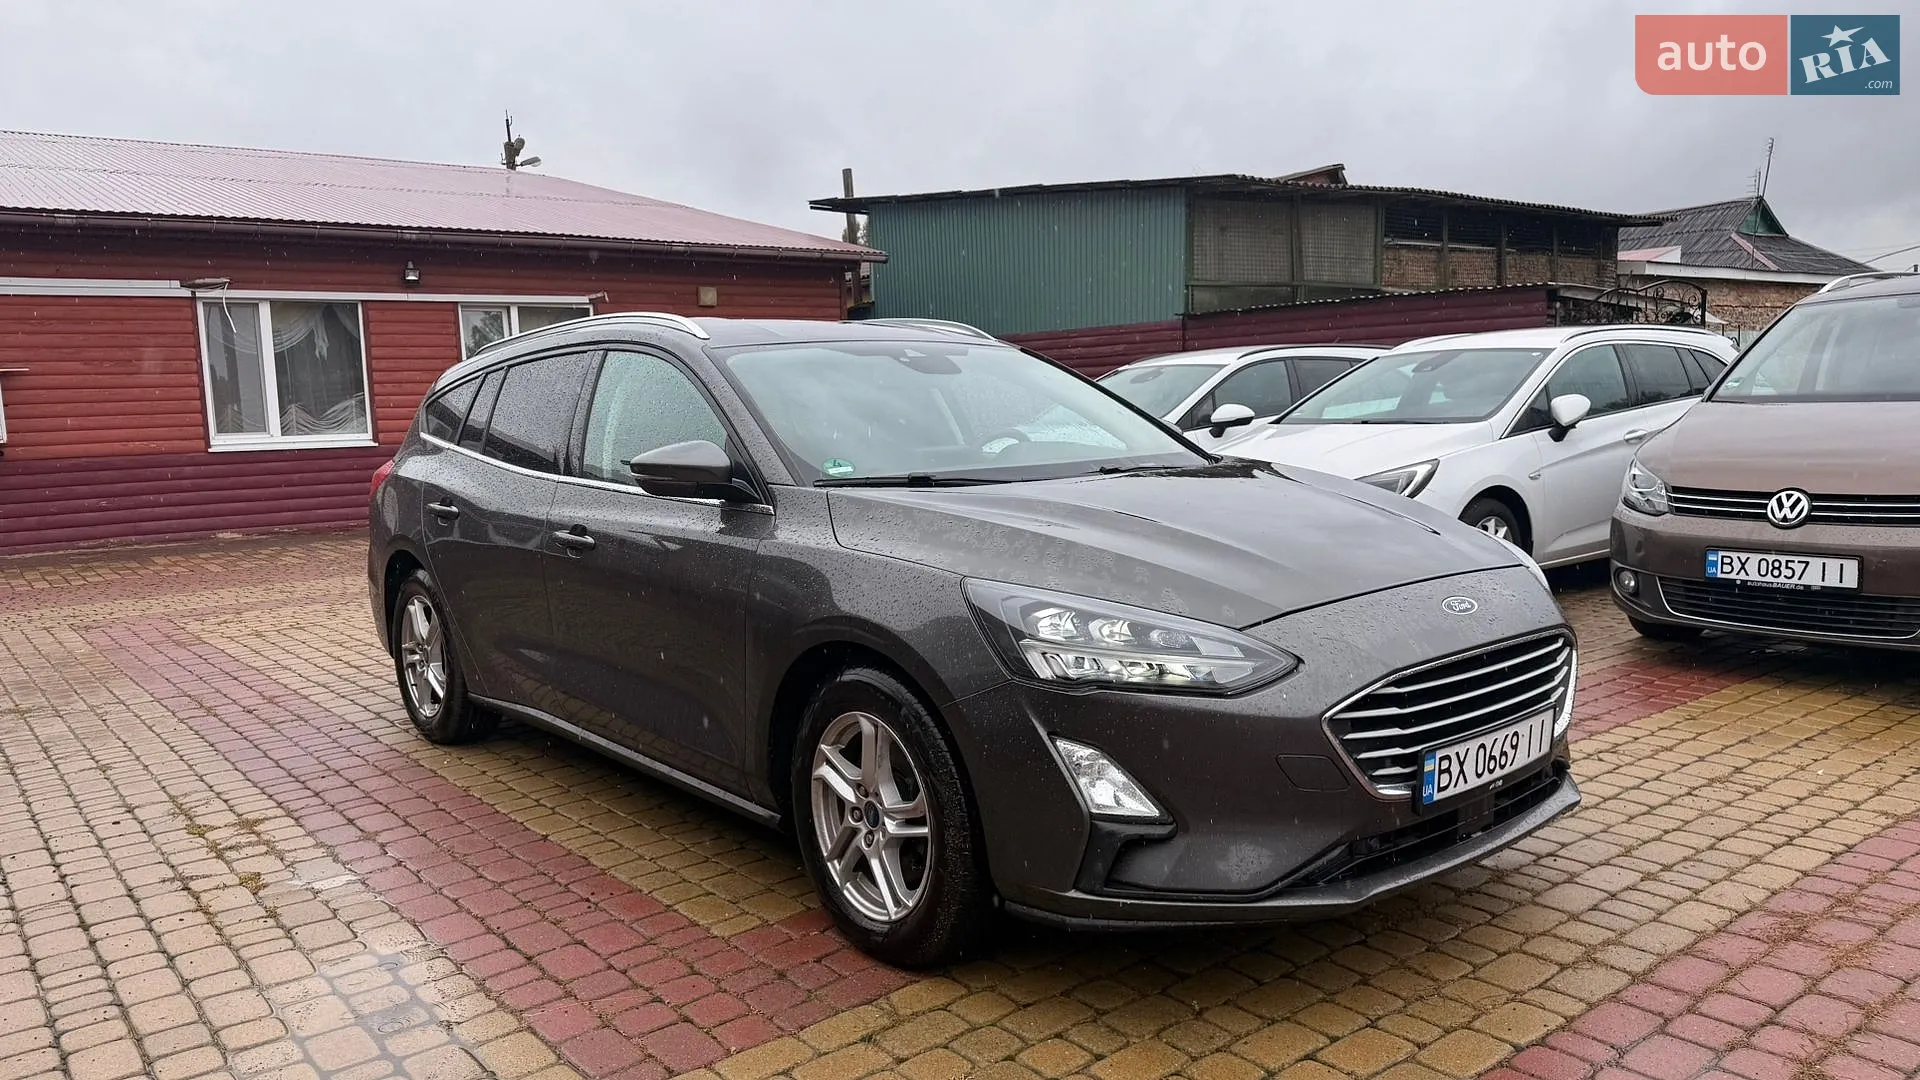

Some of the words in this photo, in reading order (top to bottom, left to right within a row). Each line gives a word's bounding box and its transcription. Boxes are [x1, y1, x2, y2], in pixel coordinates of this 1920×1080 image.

[1720, 554, 1751, 577] BX
[1757, 557, 1810, 581] 0857
[1450, 600, 1472, 611] Ford
[1437, 748, 1470, 793] BX
[1475, 730, 1520, 779] 0669
[1422, 784, 1433, 796] UA
